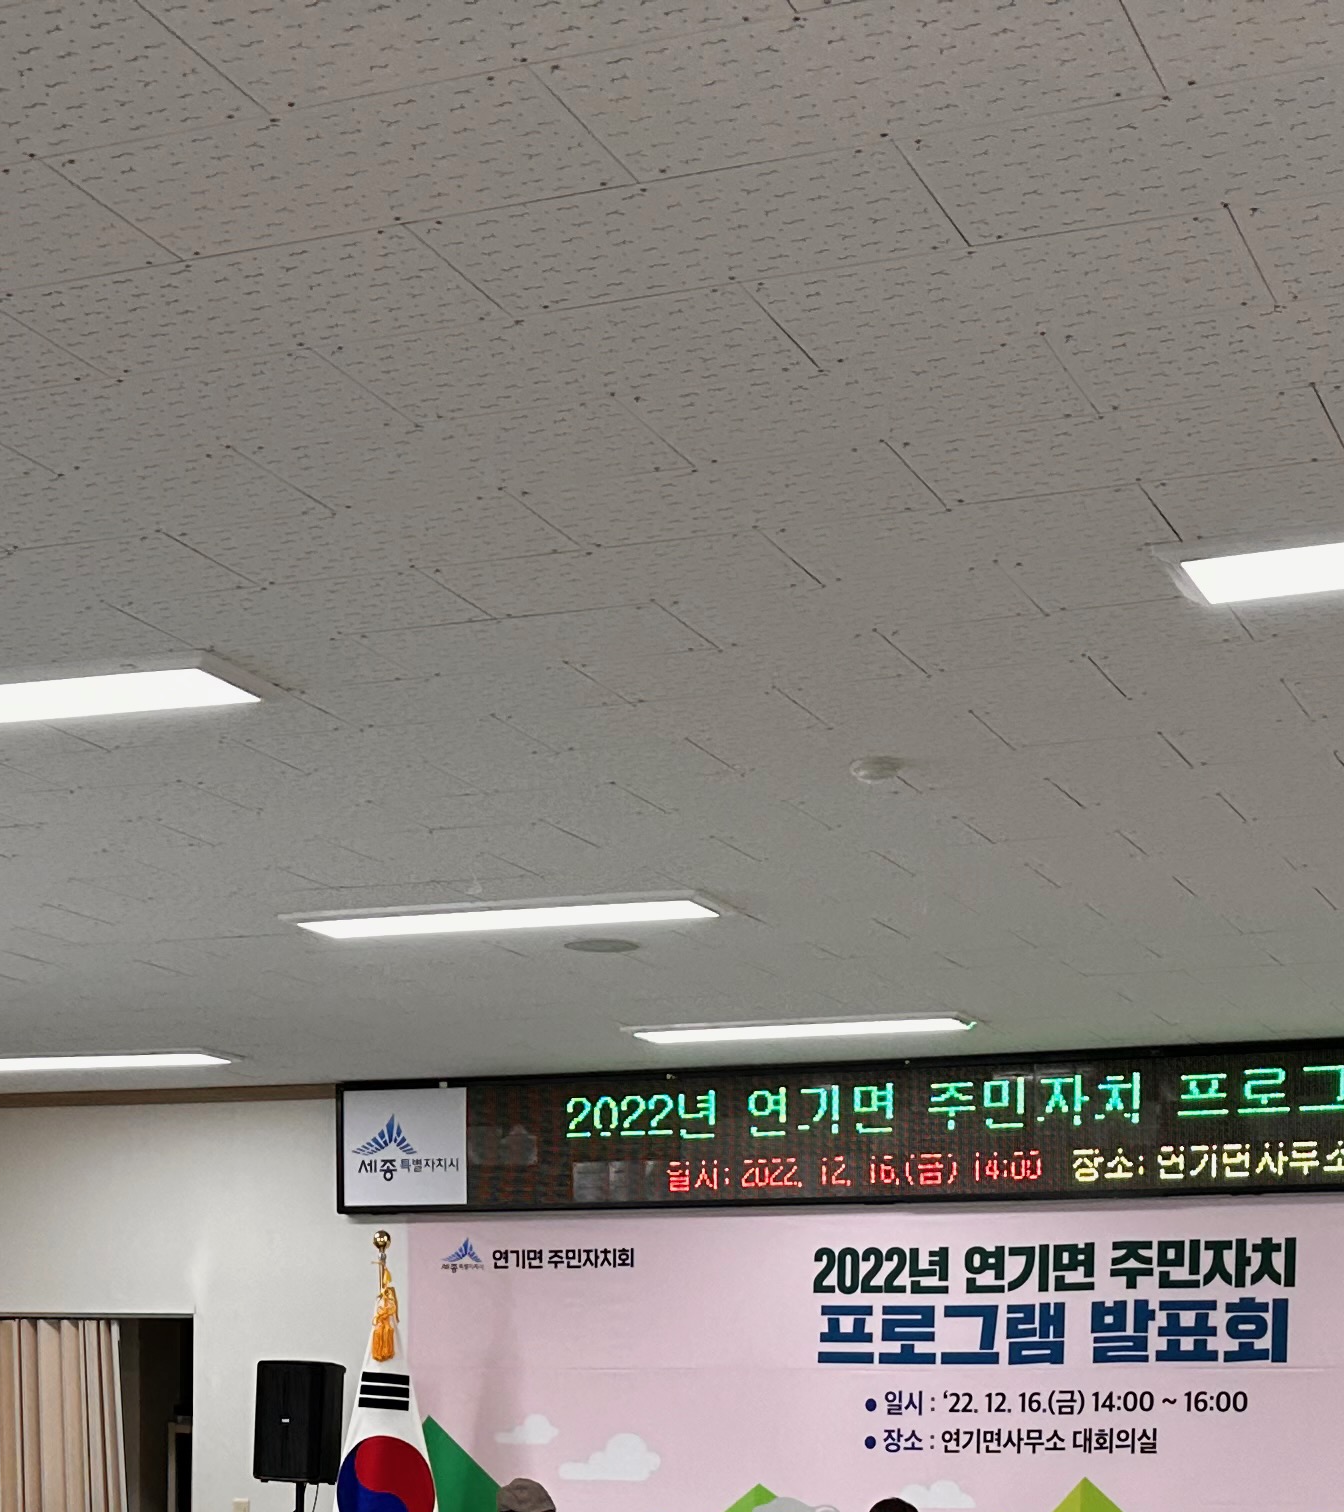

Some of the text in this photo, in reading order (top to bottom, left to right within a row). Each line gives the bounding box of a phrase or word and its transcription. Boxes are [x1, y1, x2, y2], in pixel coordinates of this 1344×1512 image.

[566, 1089, 716, 1139] 2022년
[748, 1082, 894, 1138] 연기면
[927, 1072, 1141, 1131] 주민자치
[492, 1248, 544, 1270] 연기면
[547, 1247, 635, 1270] 주민자치회
[813, 1237, 1297, 1295] 2022년 연기면 주민자치
[817, 1297, 1289, 1366] 프로그램 발표회
[985, 1392, 1012, 1413] 12.
[1018, 1390, 1086, 1416] 16.(금)
[1091, 1390, 1155, 1412] 14:00
[1183, 1390, 1249, 1413] 16:00
[941, 1428, 1066, 1454] 연기면사무소
[1072, 1427, 1158, 1454] 대회의실
